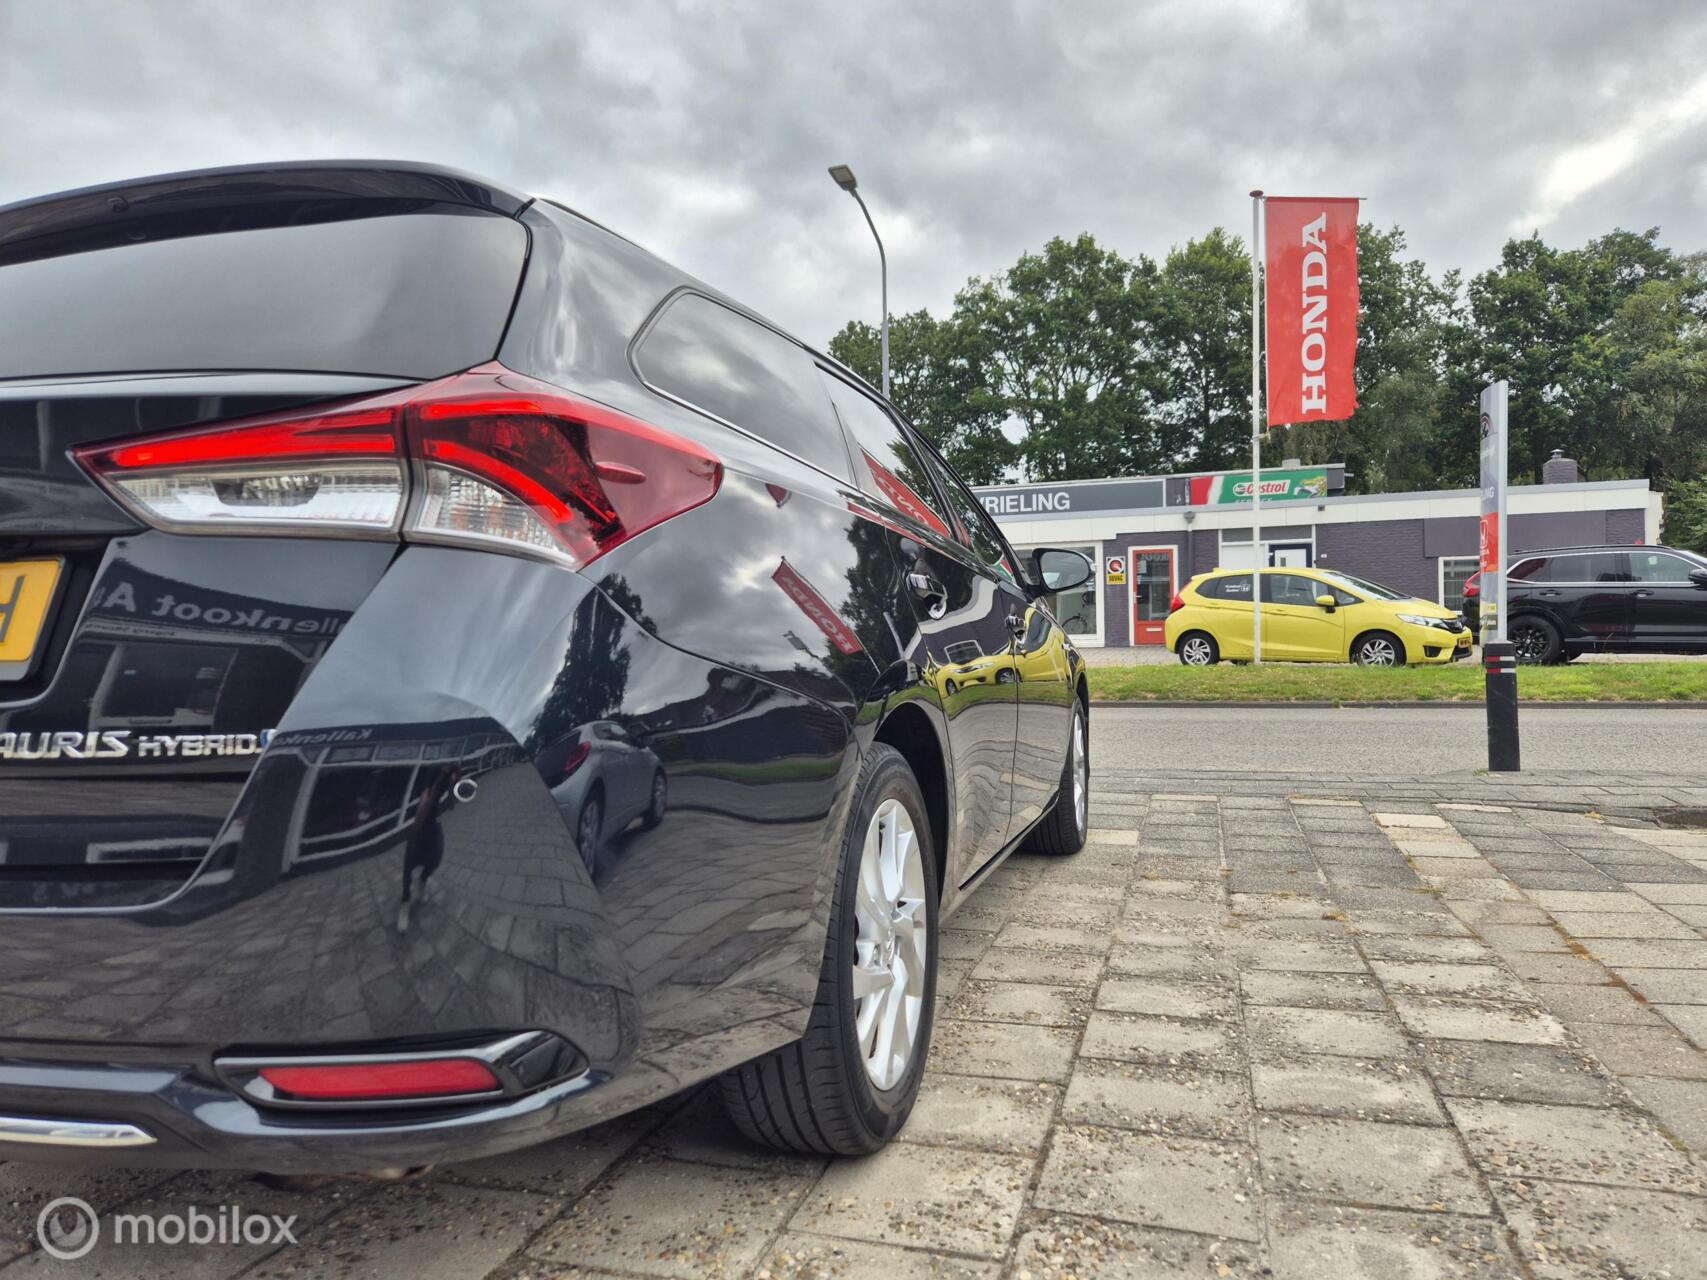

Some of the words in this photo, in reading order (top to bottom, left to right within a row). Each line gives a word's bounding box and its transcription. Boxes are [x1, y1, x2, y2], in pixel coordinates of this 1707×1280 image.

[1302, 212, 1327, 414] HONDA
[1247, 482, 1287, 495] Cstrol
[0, 731, 131, 758] AURIS
[138, 733, 258, 757] HYBRID
